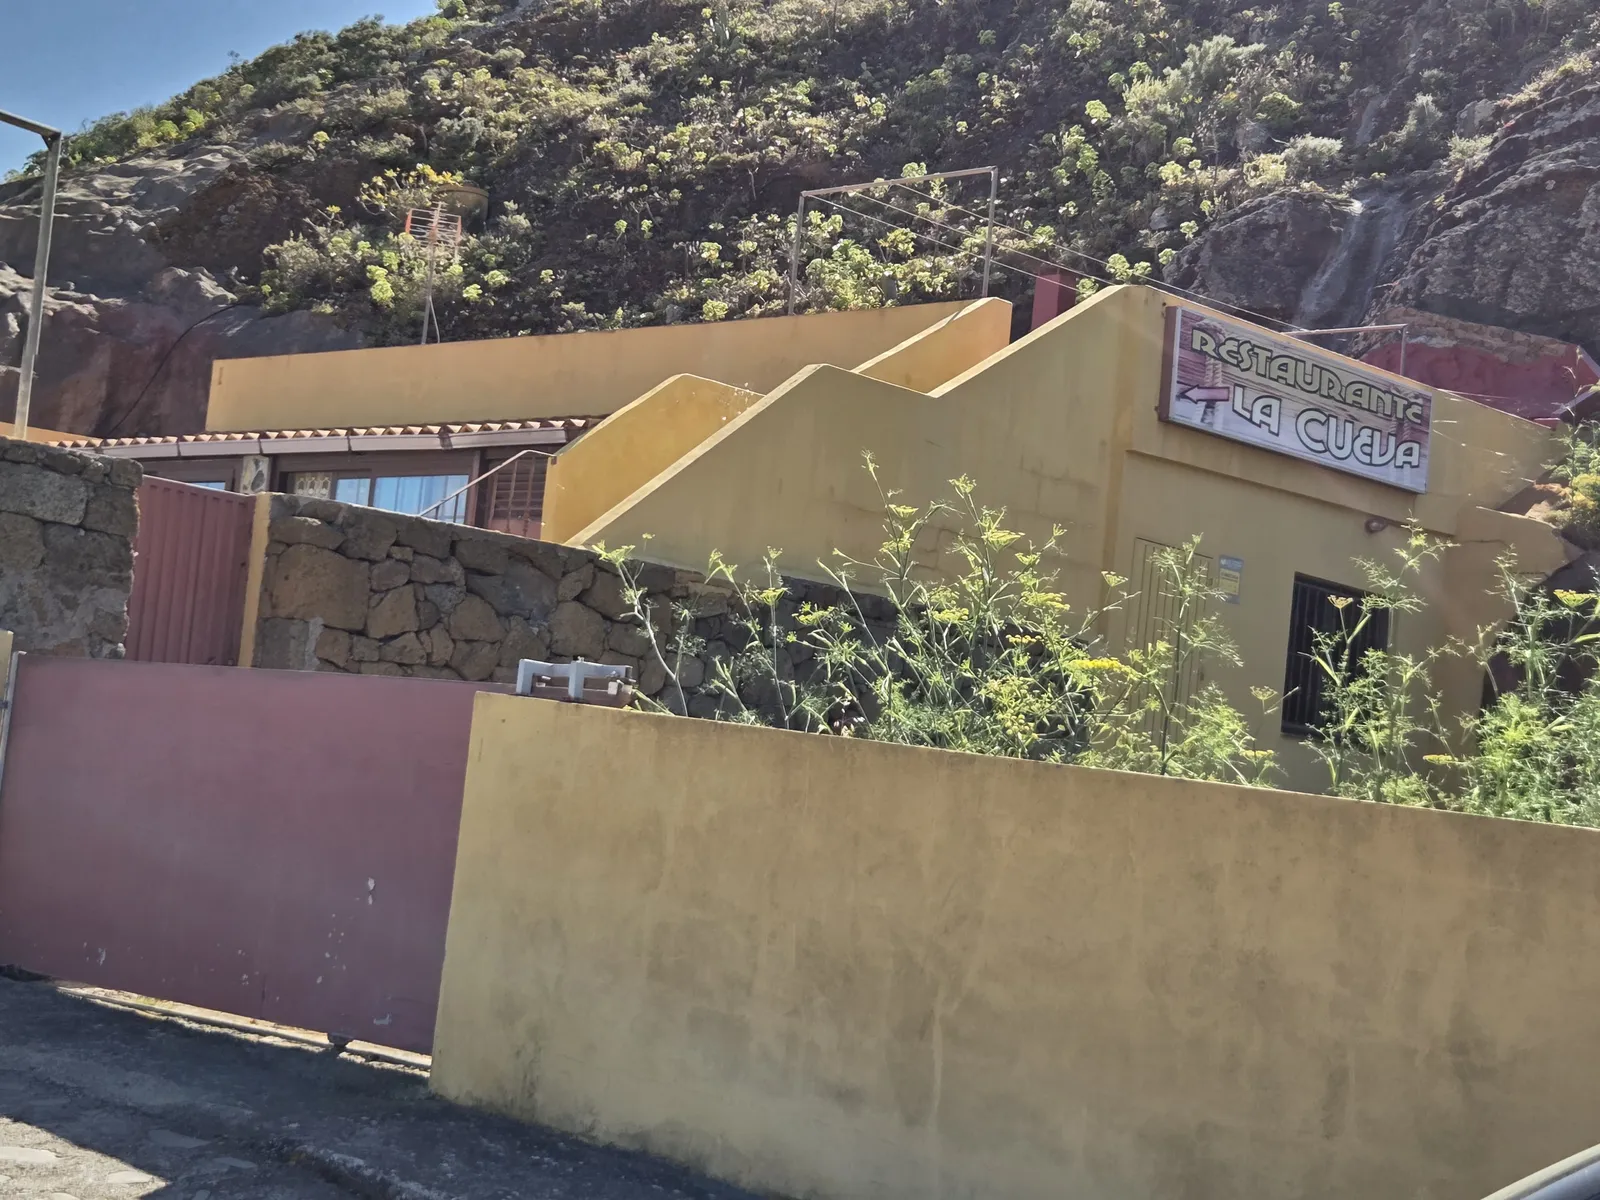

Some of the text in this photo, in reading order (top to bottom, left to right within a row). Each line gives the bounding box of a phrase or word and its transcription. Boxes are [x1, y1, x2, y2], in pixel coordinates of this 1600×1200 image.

[1191, 327, 1424, 425] RESTAURANTE
[1231, 383, 1421, 468] LA CUEVA
